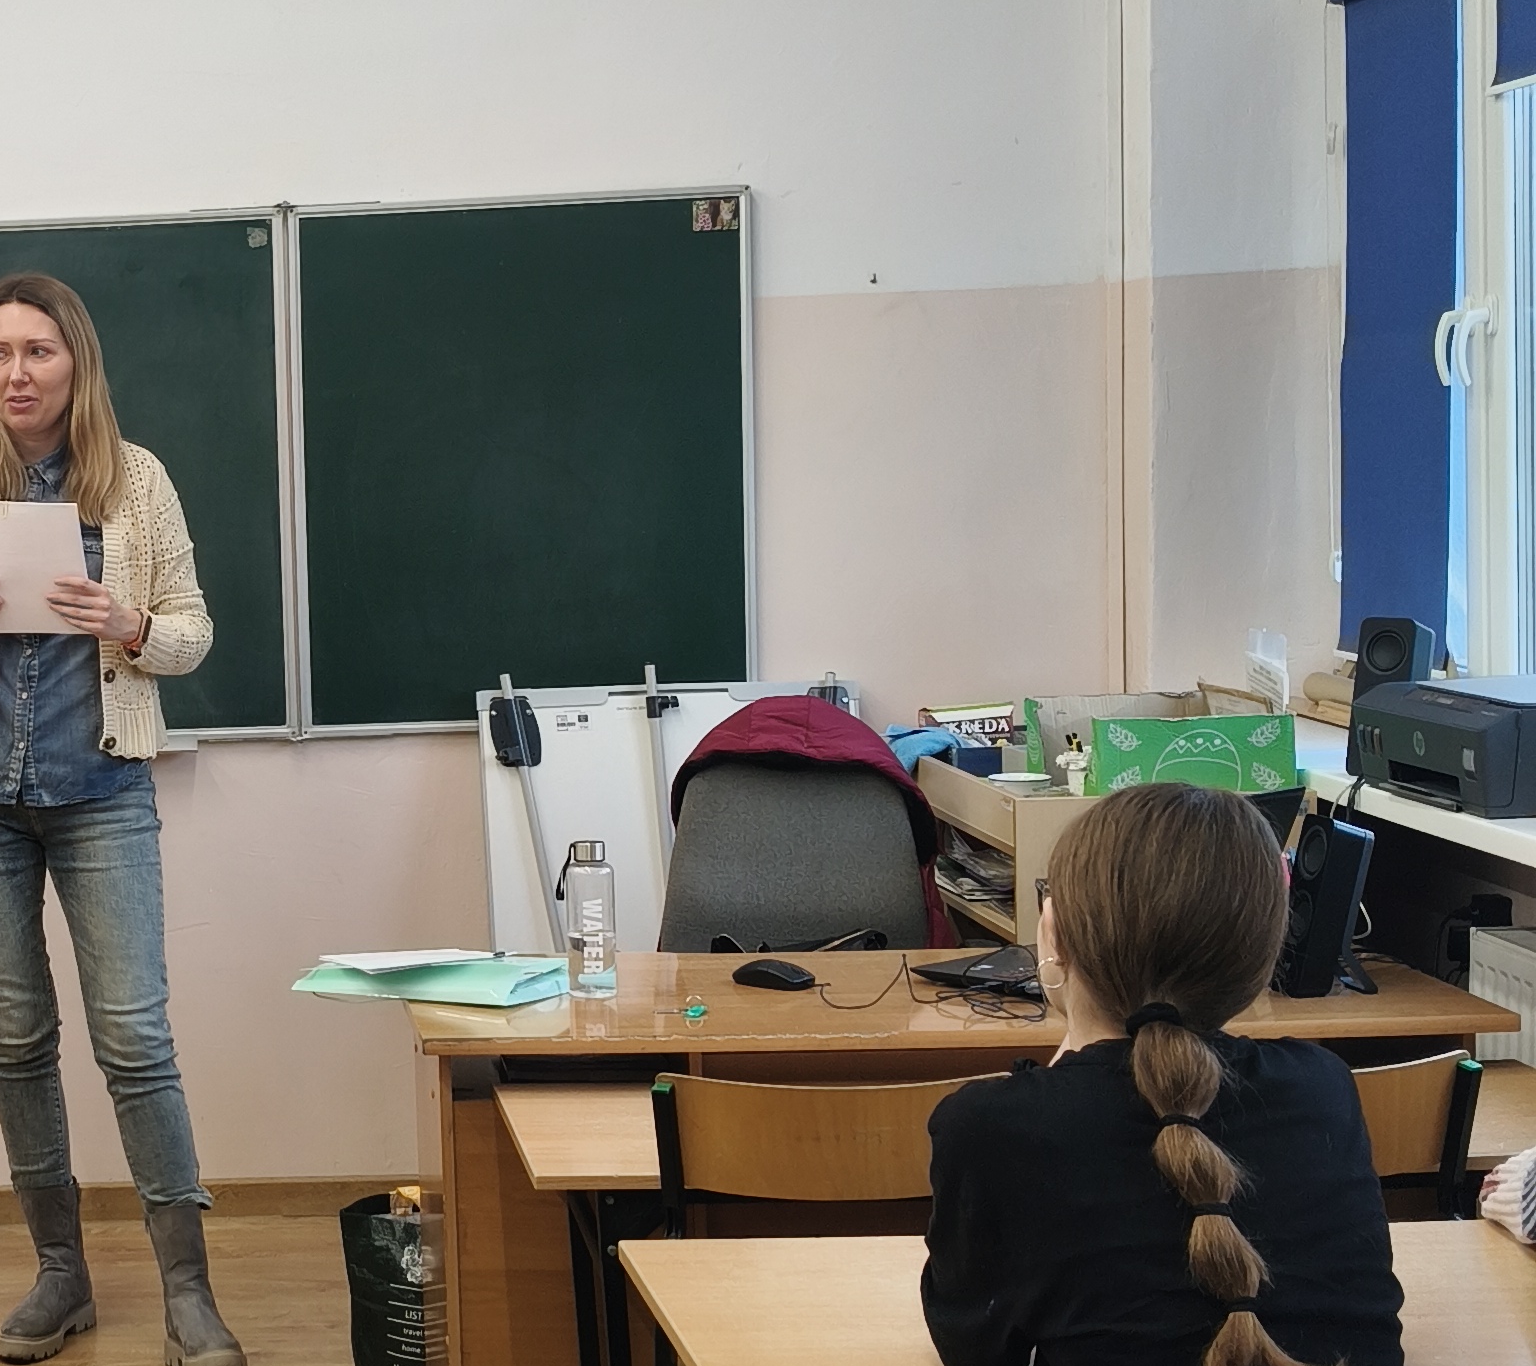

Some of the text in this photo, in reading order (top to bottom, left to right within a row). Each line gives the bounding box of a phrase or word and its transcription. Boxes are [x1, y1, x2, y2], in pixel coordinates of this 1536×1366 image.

[948, 718, 1010, 734] KREDA
[582, 898, 603, 974] WATER
[405, 1310, 423, 1321] LIST
